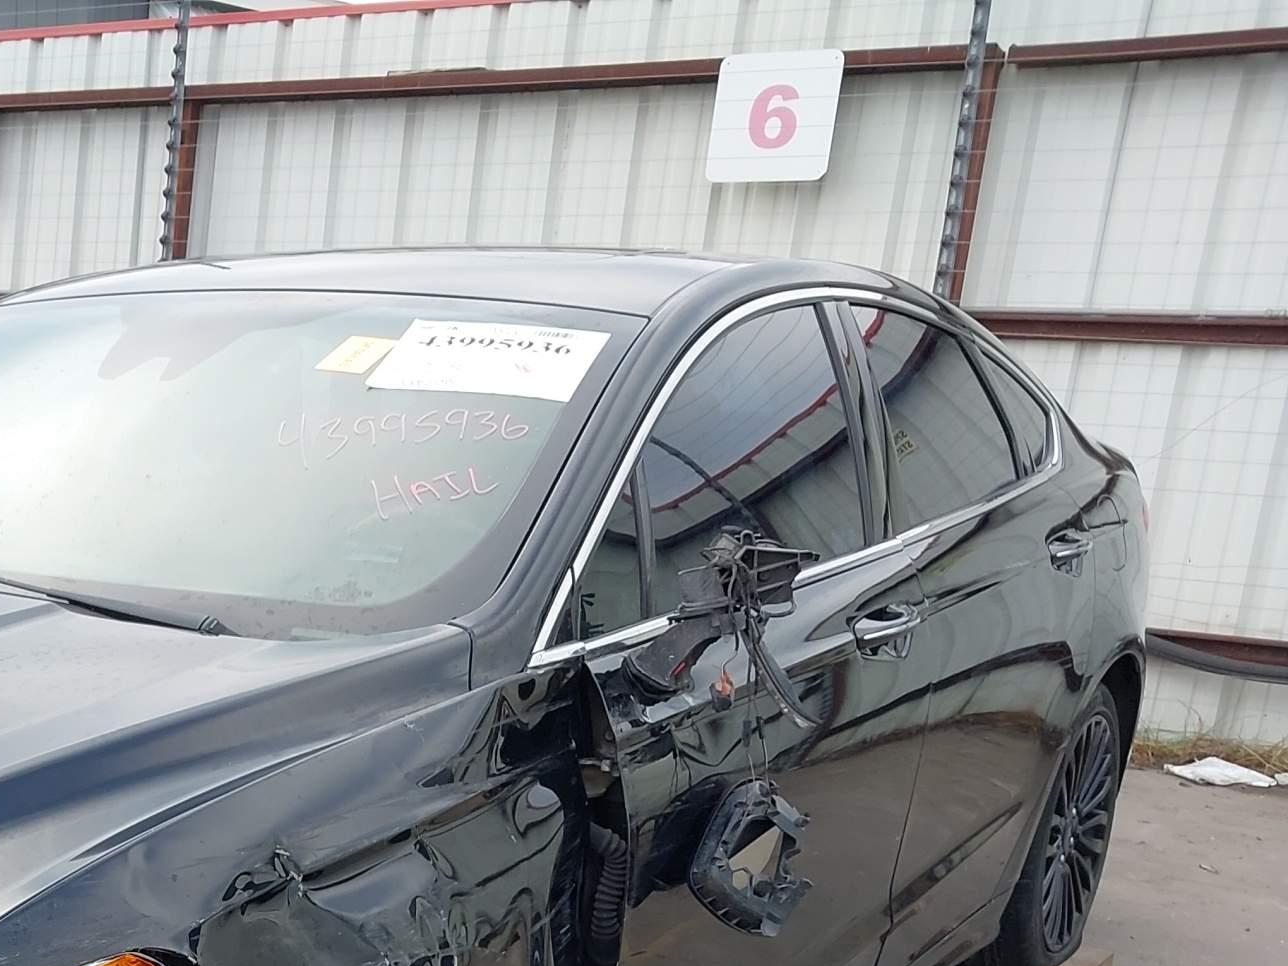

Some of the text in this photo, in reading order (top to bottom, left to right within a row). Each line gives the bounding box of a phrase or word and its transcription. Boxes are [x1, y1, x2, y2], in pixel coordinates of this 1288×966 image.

[746, 84, 800, 148] 6
[278, 407, 529, 470] 43995936
[371, 466, 500, 520] HAIL
